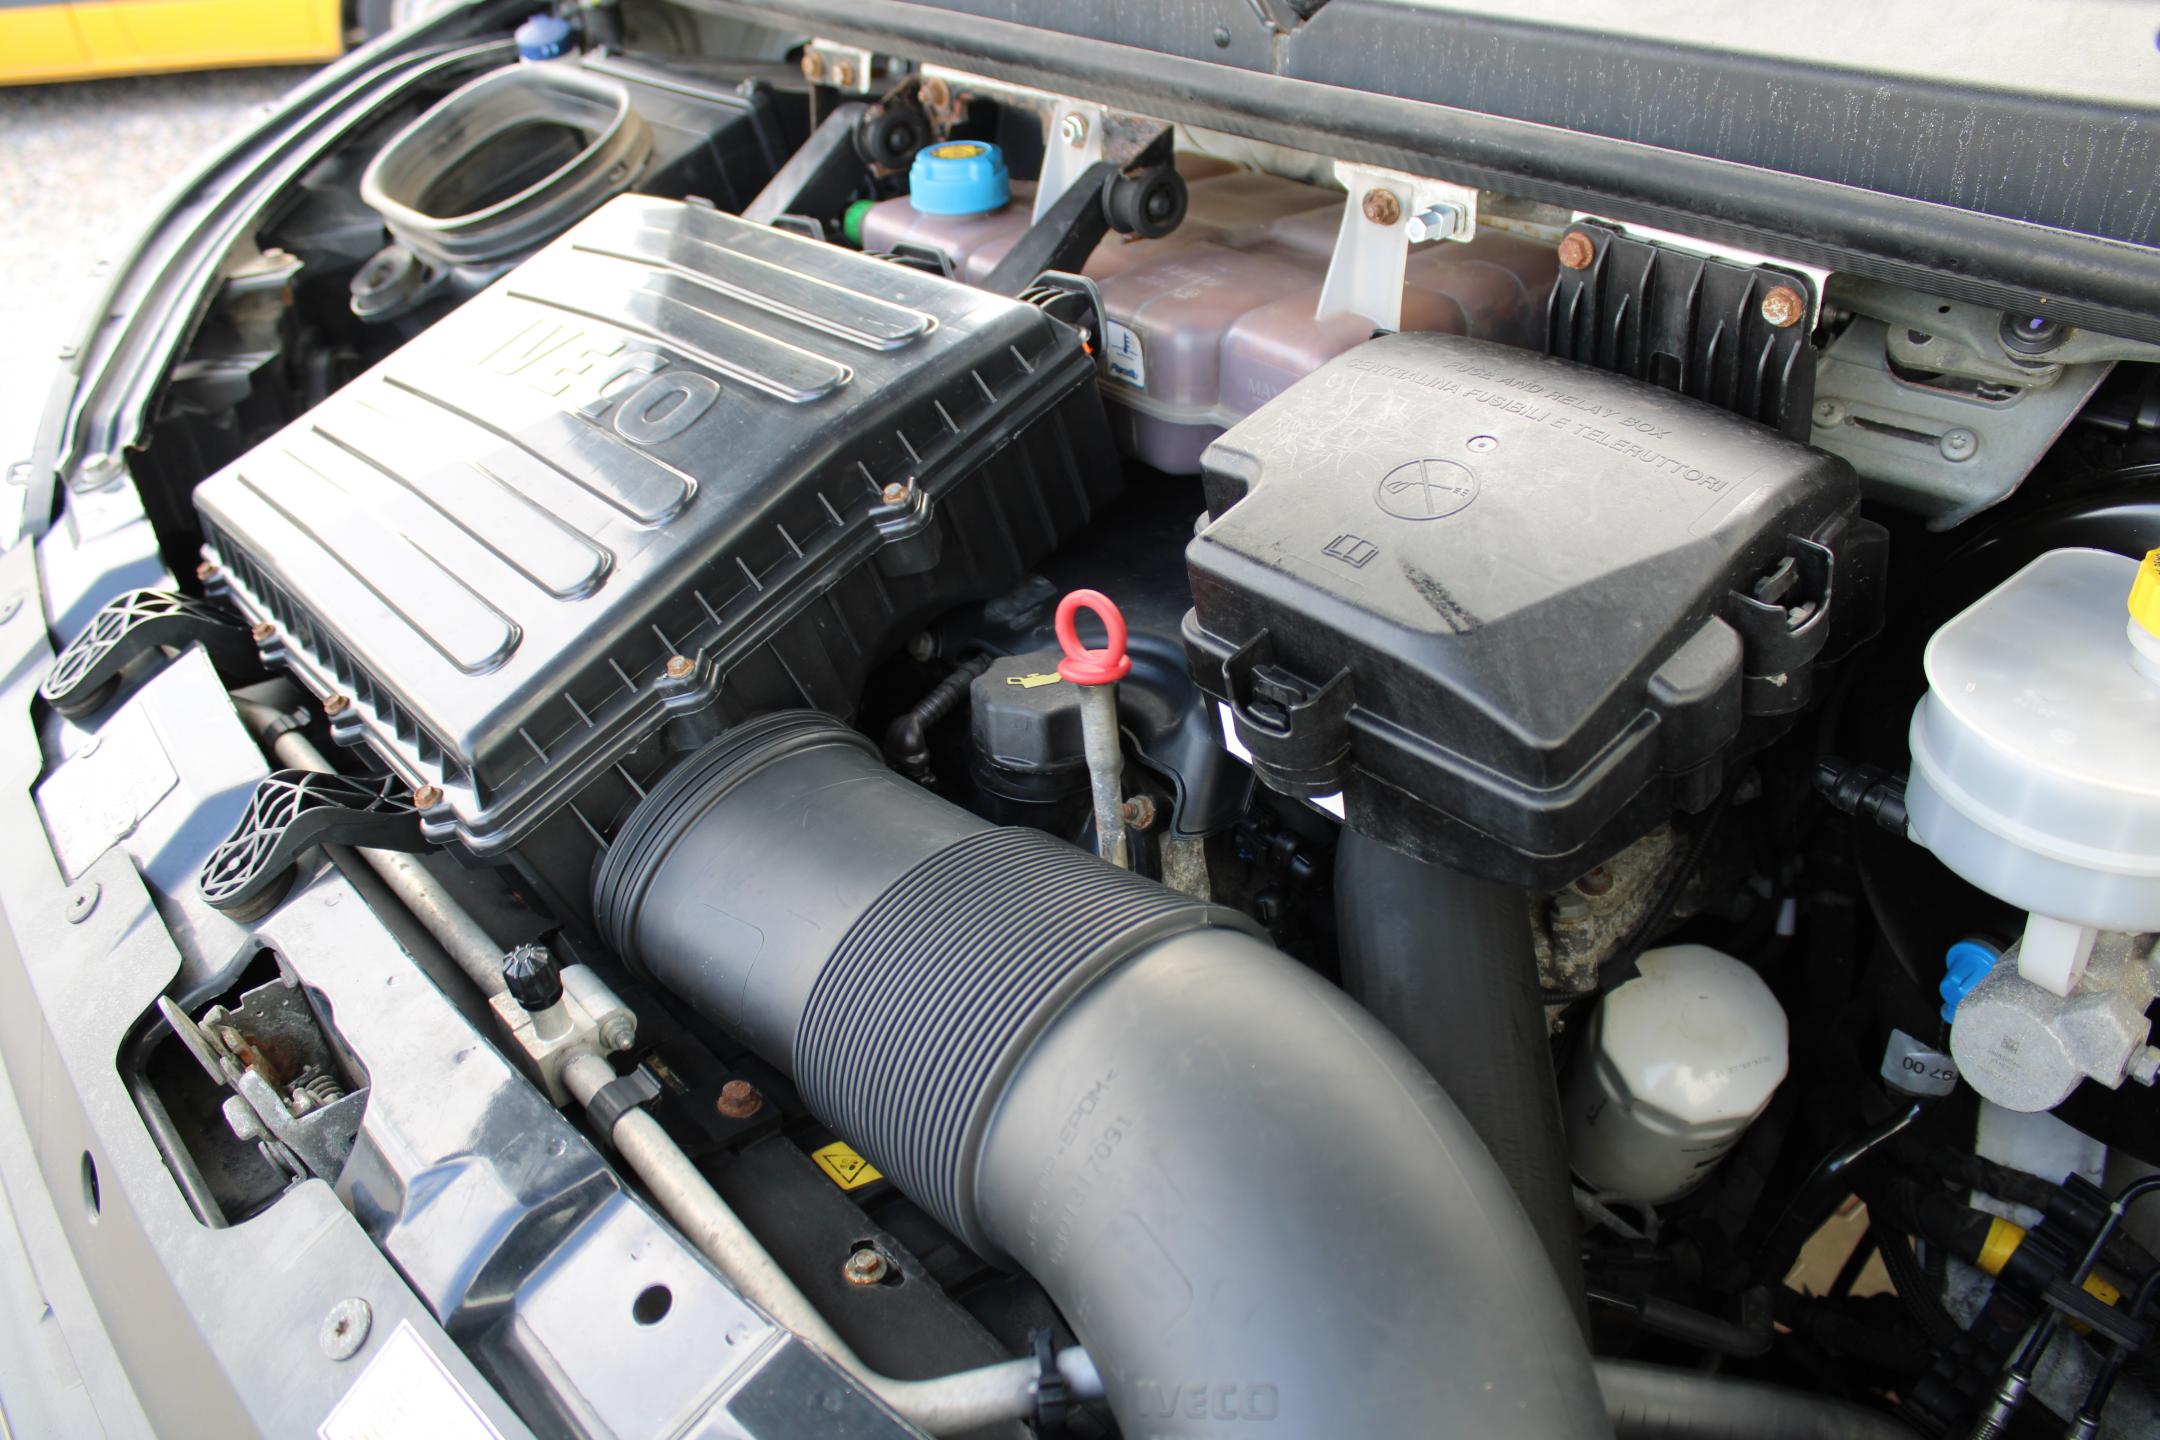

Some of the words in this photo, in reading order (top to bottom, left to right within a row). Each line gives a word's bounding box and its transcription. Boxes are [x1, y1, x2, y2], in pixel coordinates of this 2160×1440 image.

[470, 316, 720, 445] IVECO
[1347, 358, 1461, 394] CENTRALINA
[1463, 387, 1551, 422] FUSIBILI
[1550, 417, 1572, 430] E
[1573, 423, 1729, 493] TELERUTTORI
[1442, 359, 1496, 381] FUSE
[1496, 374, 1545, 394] AND
[1544, 391, 1620, 418] RELAY
[1618, 417, 1673, 440] BOX
[1136, 1379, 1280, 1422] IVECO
